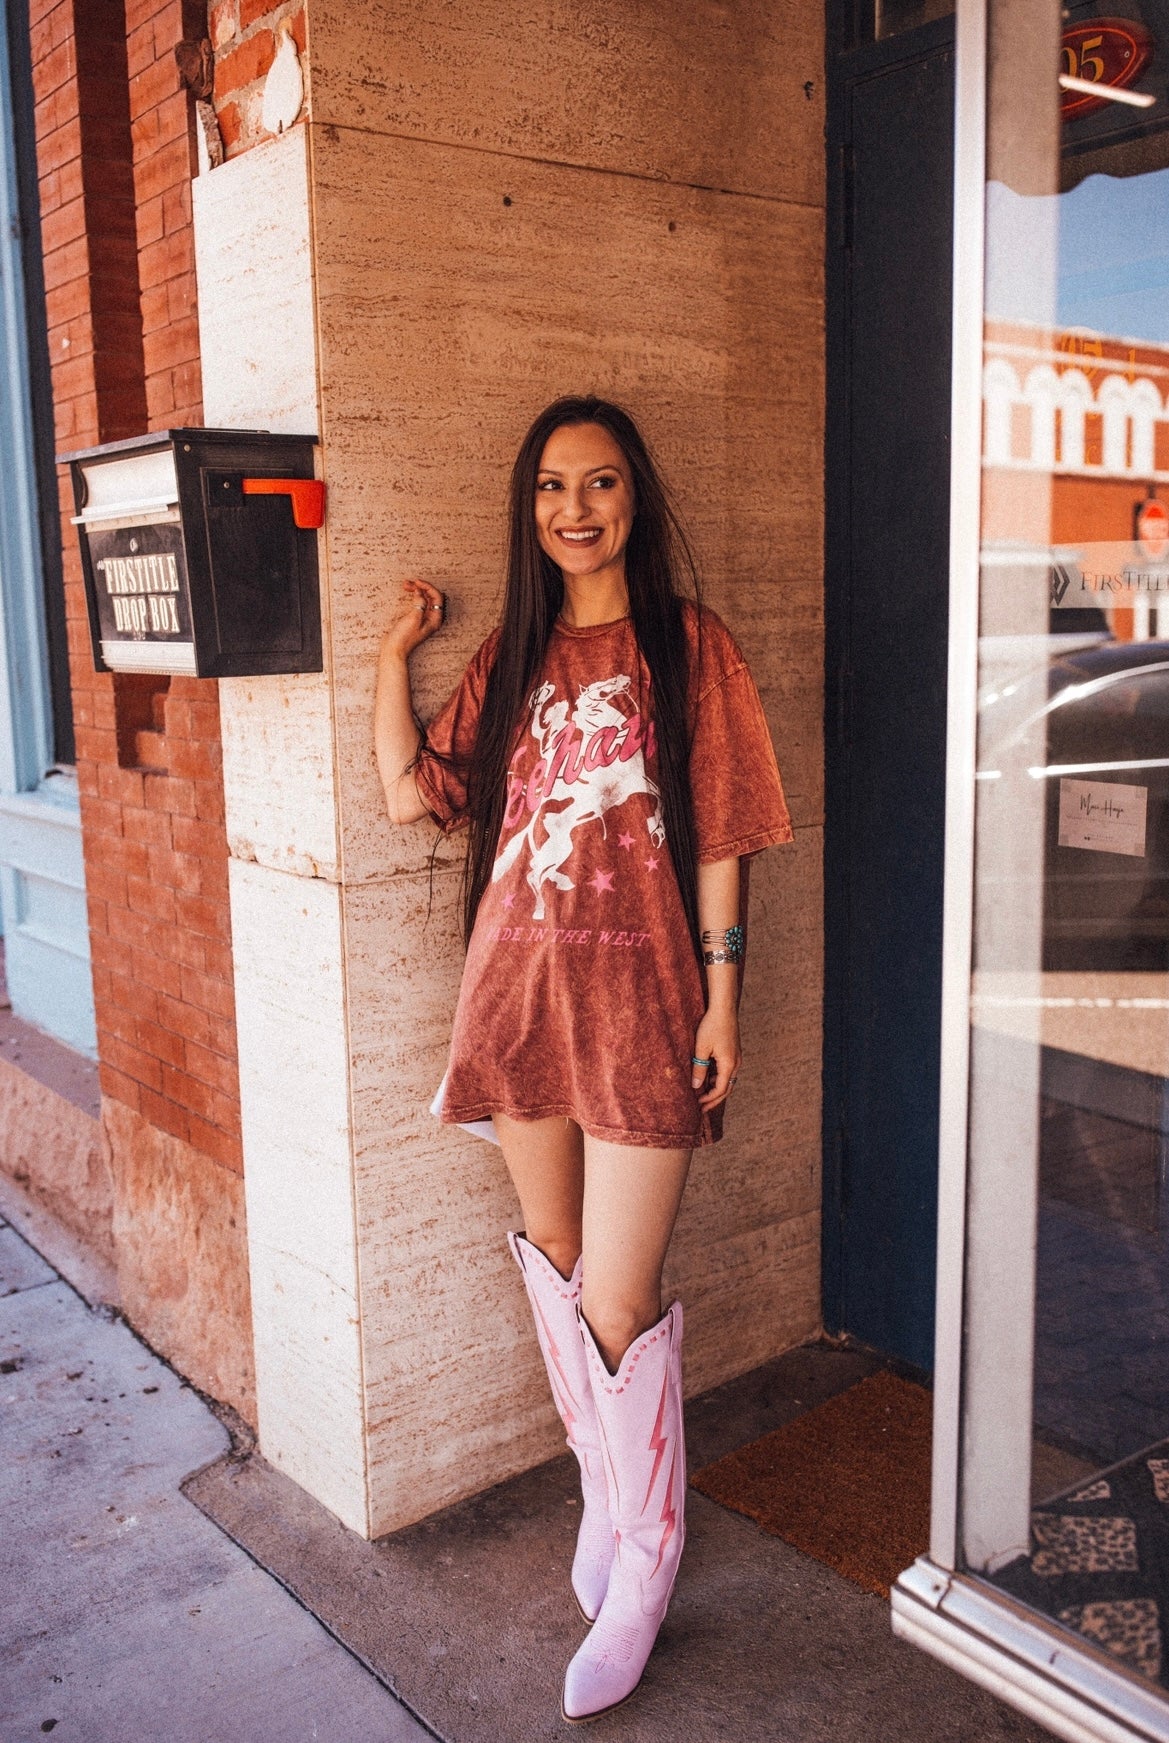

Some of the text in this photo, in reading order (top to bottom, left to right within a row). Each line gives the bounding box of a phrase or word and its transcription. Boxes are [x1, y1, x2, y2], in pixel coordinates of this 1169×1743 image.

[104, 555, 180, 593] FIRSTITLE
[1080, 570, 1169, 595] FIRSTITL
[113, 597, 180, 633] DROP BOX
[526, 927, 550, 943] IN
[550, 928, 593, 945] THE
[597, 930, 652, 947] WEST
